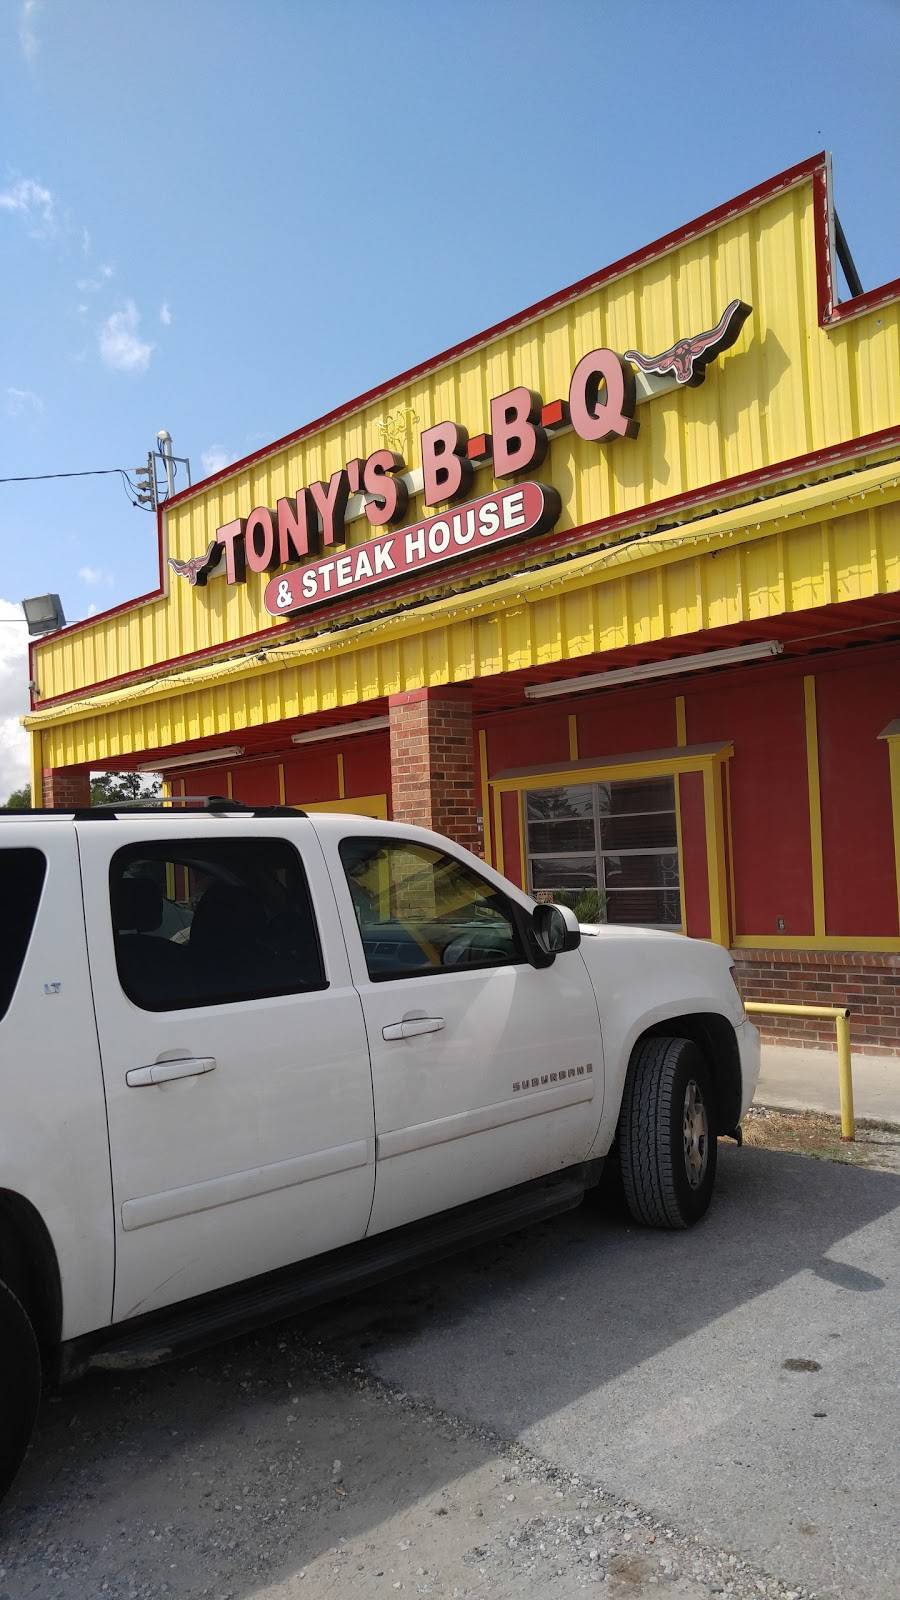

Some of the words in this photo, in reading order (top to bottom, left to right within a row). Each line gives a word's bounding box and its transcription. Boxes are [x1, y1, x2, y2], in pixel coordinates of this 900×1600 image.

[216, 449, 400, 585] TONY'S
[419, 347, 631, 508] B-B-Q
[276, 580, 293, 608] &
[302, 540, 396, 598] STEAK
[405, 491, 526, 564] HOUSE
[512, 1065, 584, 1092] SUBURBAN
